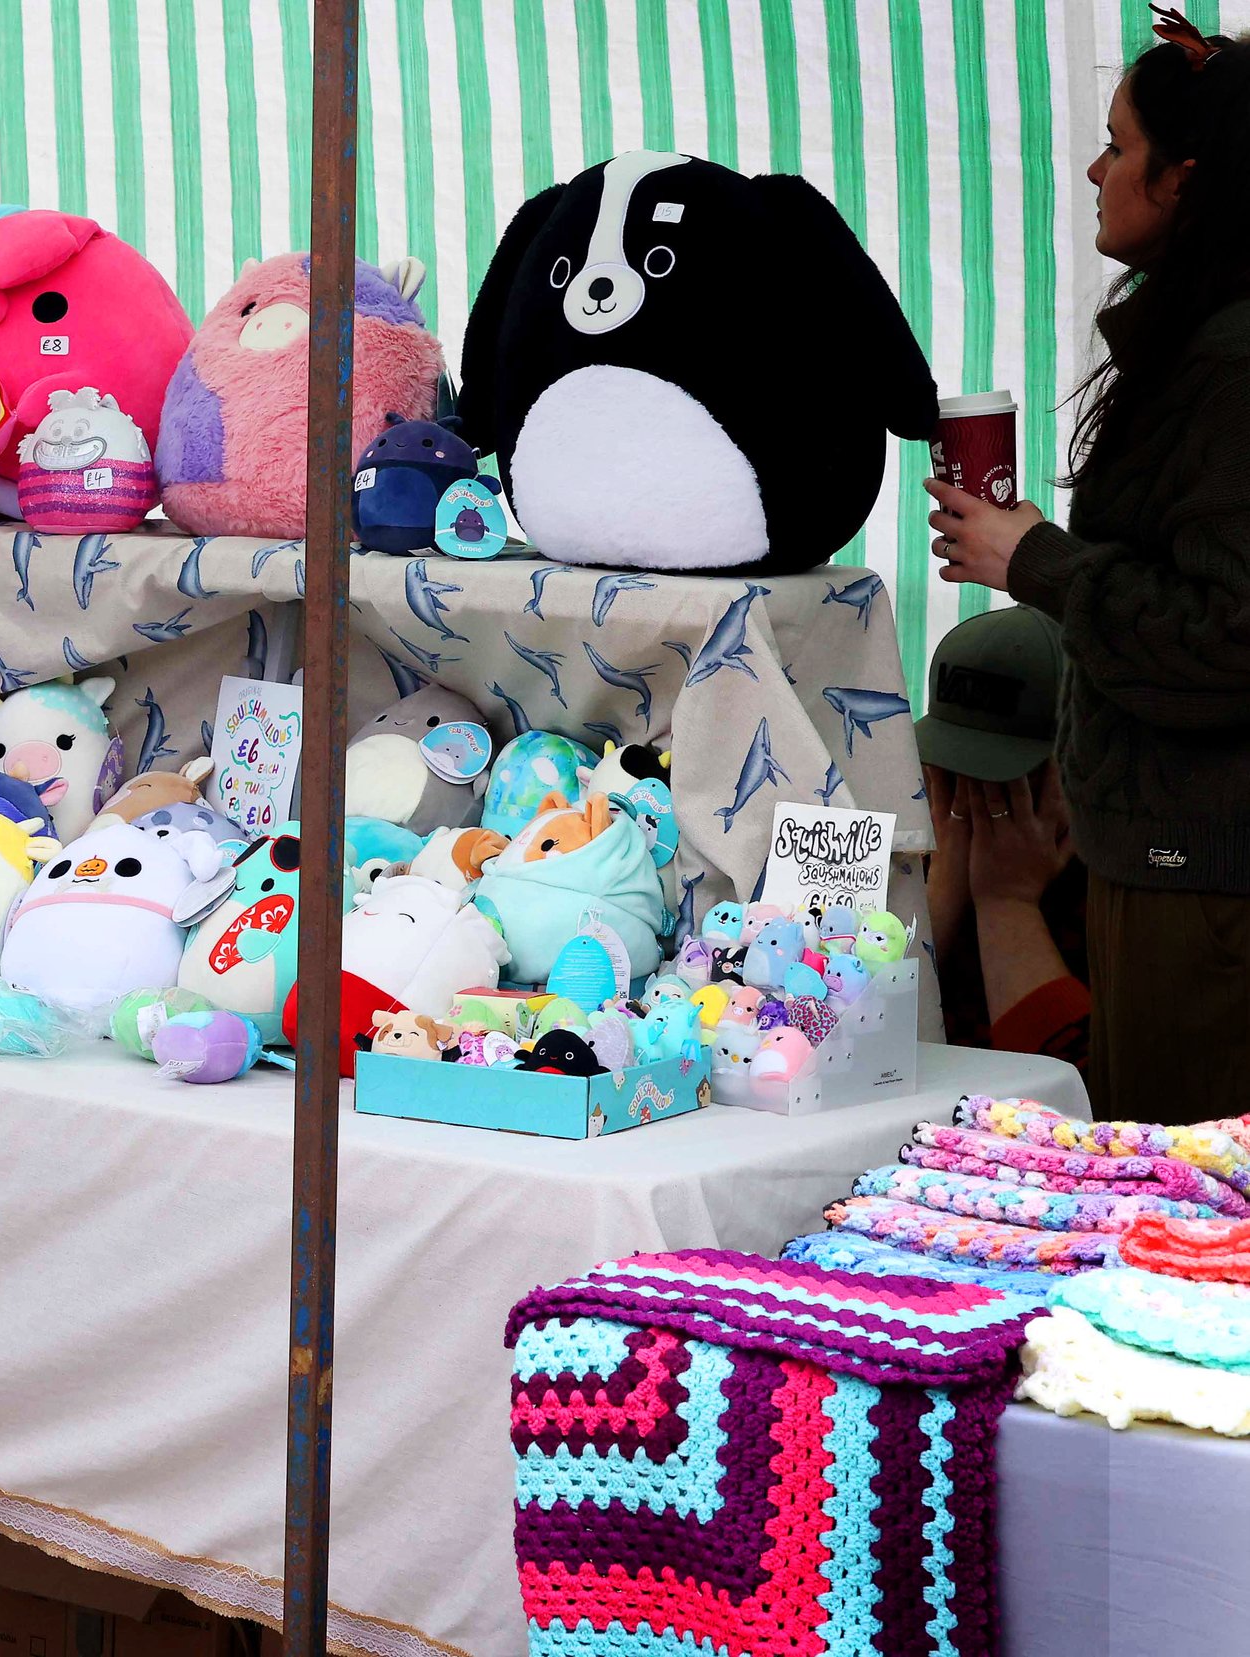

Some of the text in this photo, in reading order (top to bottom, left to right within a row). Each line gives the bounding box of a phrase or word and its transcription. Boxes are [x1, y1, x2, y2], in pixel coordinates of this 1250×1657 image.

[42, 339, 62, 351] £8
[952, 463, 963, 489] FEE
[226, 699, 293, 743] SQUISHMALLOWS
[237, 738, 259, 764] £6
[257, 763, 279, 775] EACH
[225, 777, 265, 796] OR TWO
[246, 804, 271, 826] £10
[775, 815, 882, 866] Squishville
[1148, 848, 1187, 868] Superdry
[802, 864, 880, 888] SQUISHMALLOWS
